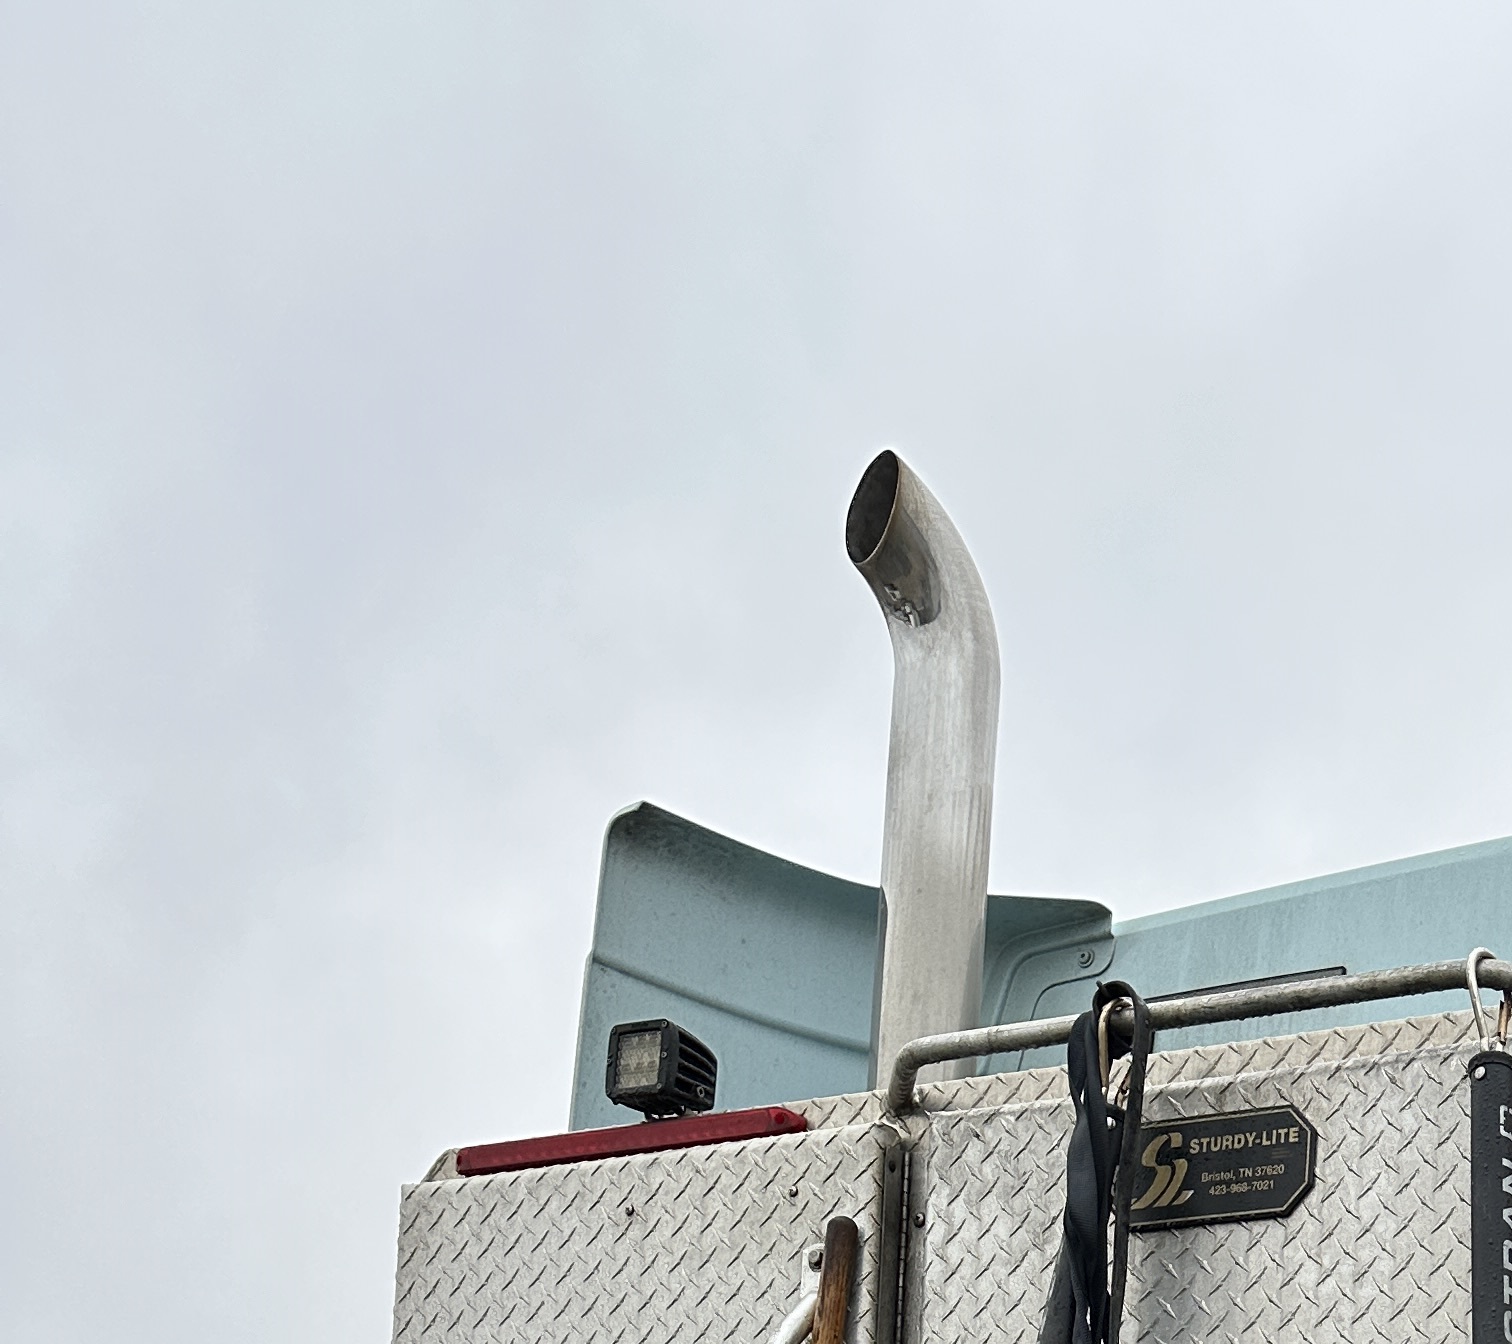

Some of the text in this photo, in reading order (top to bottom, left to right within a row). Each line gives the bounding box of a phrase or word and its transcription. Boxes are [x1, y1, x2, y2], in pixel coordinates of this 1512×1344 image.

[1189, 1126, 1300, 1154] STURDY-LITE
[1201, 1164, 1285, 1183] Bristol, TN 37620
